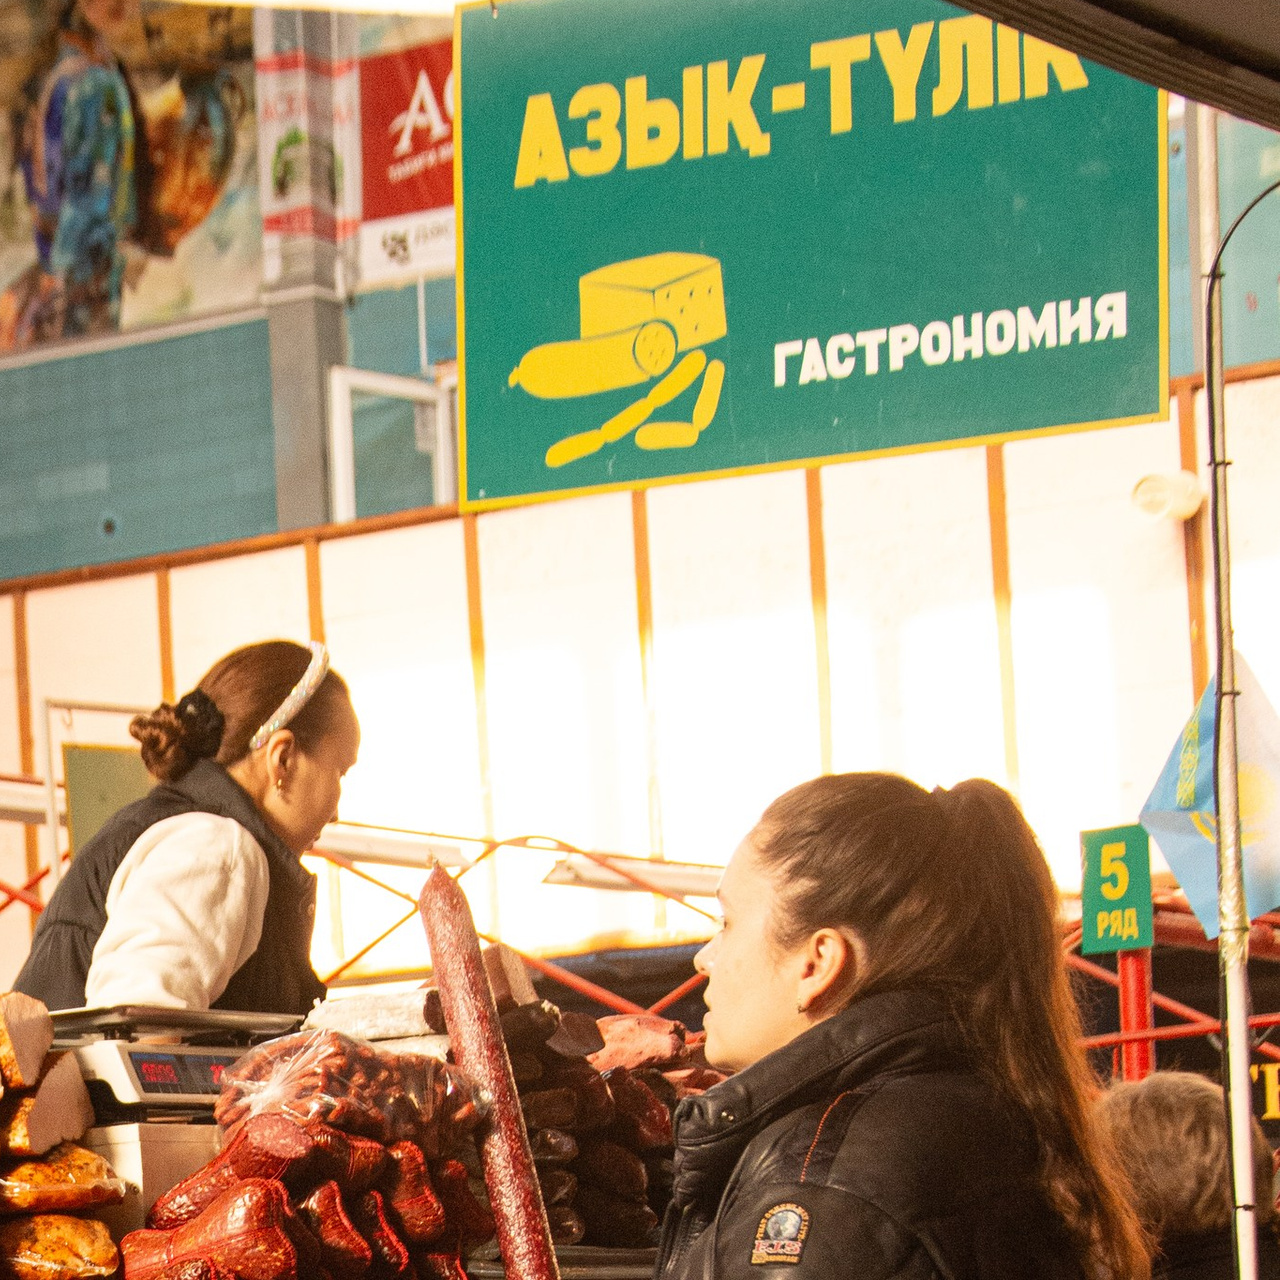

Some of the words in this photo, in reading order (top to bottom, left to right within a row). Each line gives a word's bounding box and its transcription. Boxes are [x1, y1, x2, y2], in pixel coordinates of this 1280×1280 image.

[774, 290, 1127, 388] ГАСТРОНОМИЯ
[1100, 841, 1129, 901] 5
[1096, 907, 1139, 941] РЯД
